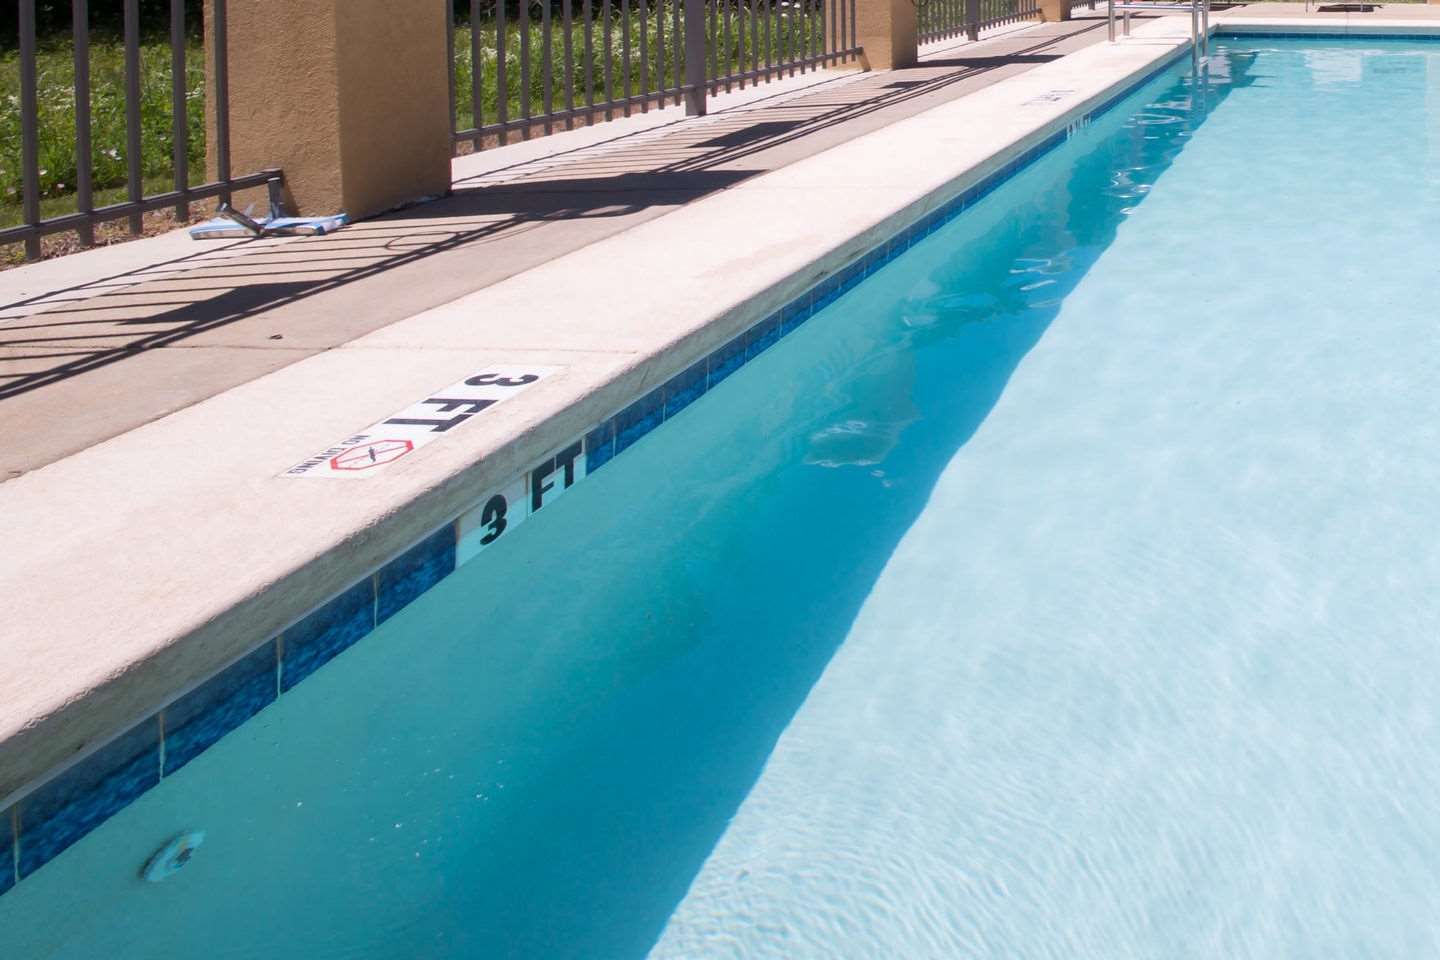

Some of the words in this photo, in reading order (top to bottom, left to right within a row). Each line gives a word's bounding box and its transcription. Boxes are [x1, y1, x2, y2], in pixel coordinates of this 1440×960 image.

[465, 373, 539, 387] 3
[383, 398, 499, 432] FT
[286, 447, 345, 474] DIVING
[480, 493, 508, 546] 3
[532, 440, 582, 514] FT
